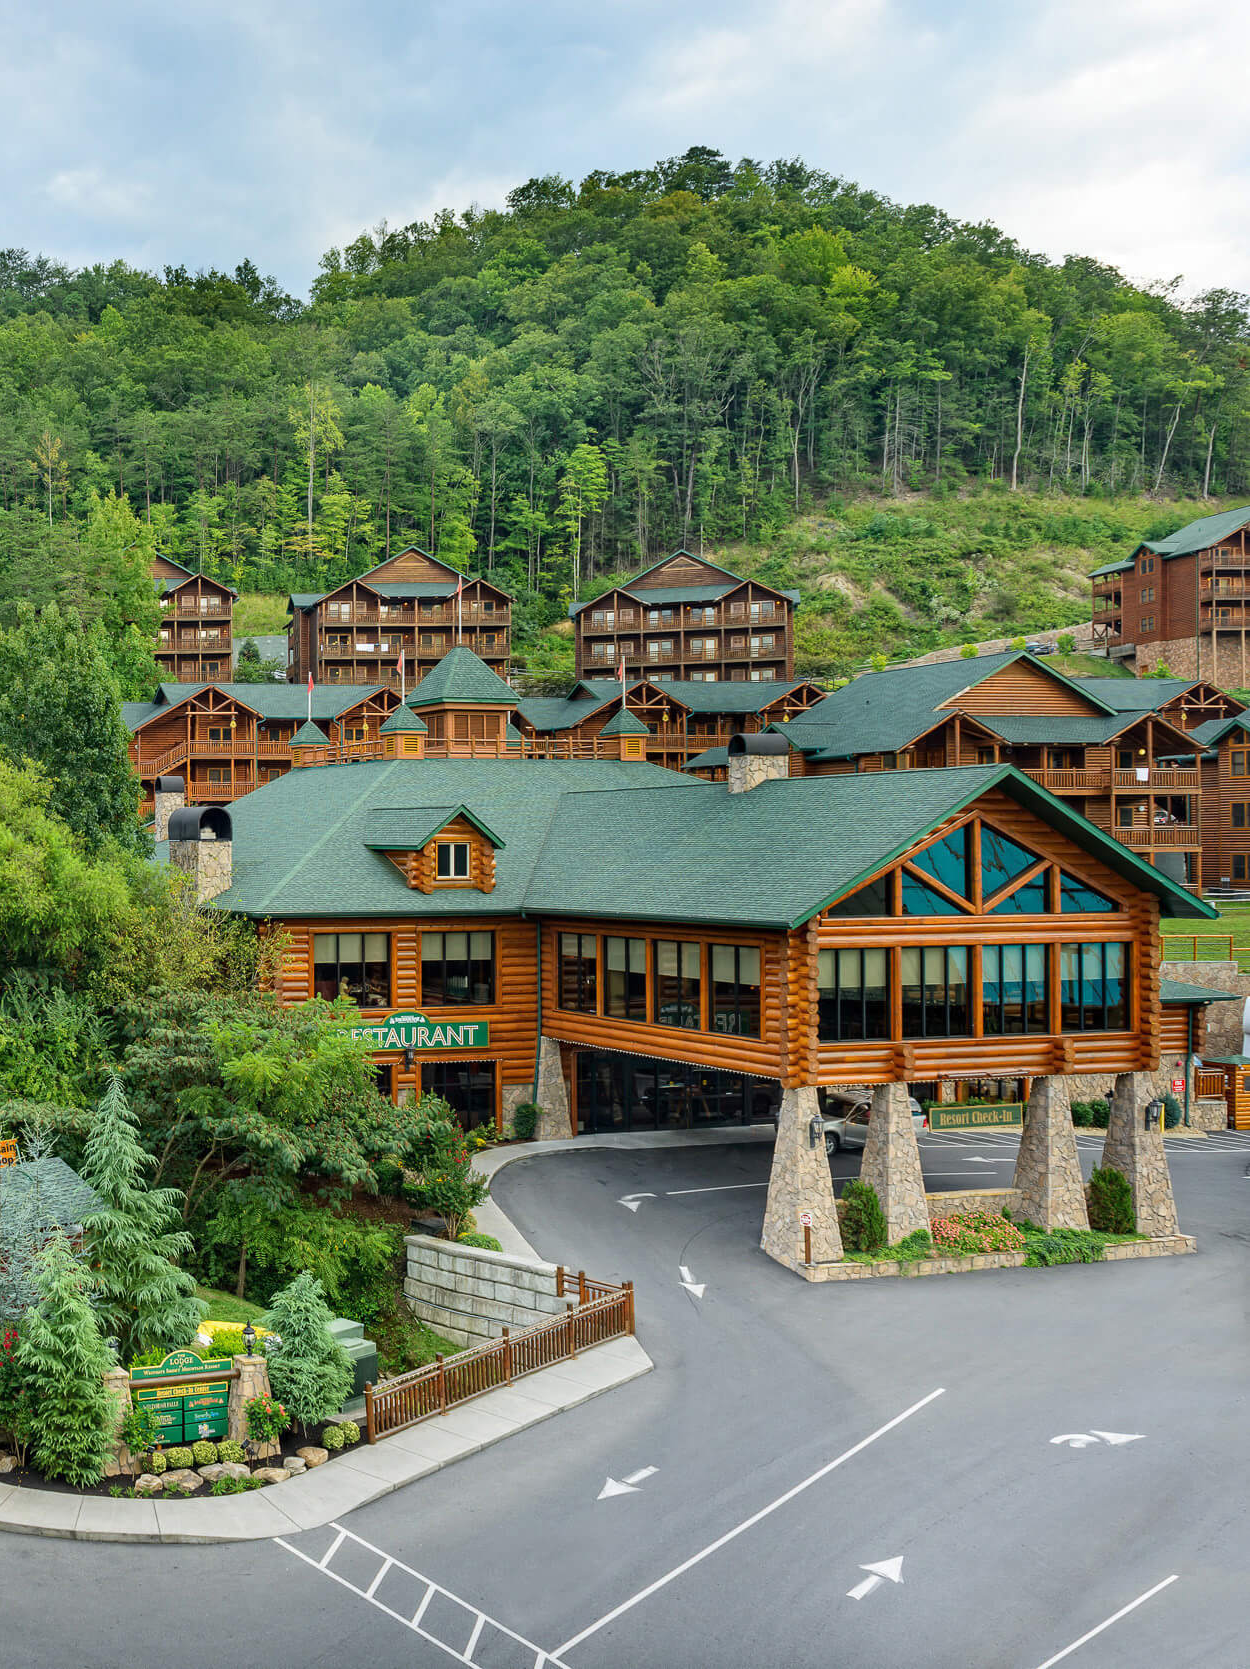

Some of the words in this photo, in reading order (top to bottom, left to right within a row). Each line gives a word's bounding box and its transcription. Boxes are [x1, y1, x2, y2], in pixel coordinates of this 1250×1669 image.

[940, 1112, 969, 1126] Resort
[972, 1110, 1014, 1124] Check-In
[170, 1357, 193, 1366] LODGE
